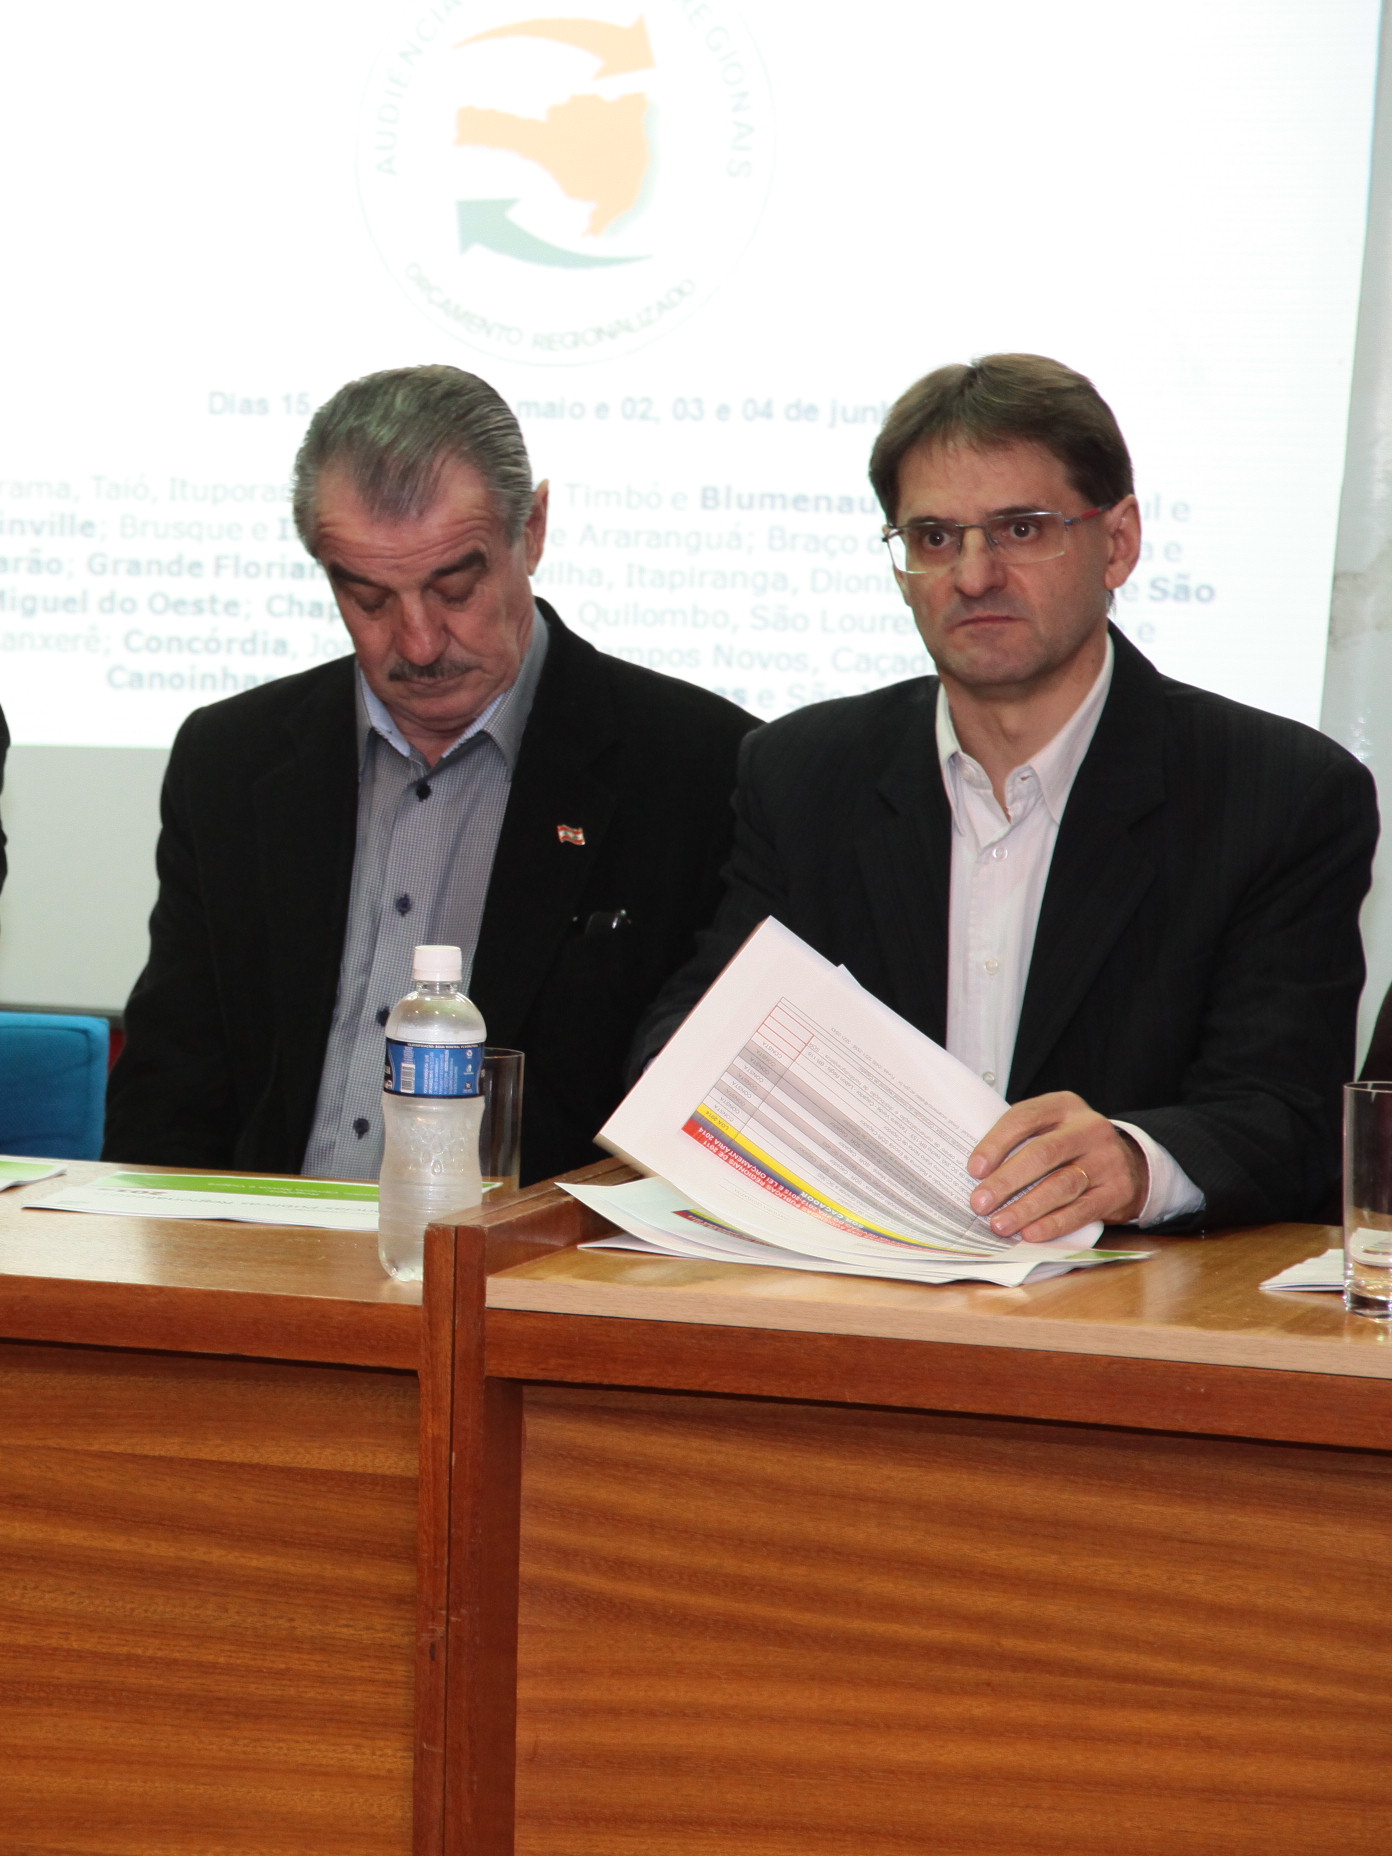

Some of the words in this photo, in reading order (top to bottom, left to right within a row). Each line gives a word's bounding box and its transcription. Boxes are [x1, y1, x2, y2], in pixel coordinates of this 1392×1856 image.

[209, 391, 269, 416] Dias
[516, 396, 586, 421] maio
[594, 402, 610, 421] e
[621, 396, 660, 424] 02,
[672, 398, 705, 422] 03
[716, 403, 732, 422] e
[743, 397, 775, 422] 04
[784, 398, 820, 424] de
[91, 473, 159, 505] Taió,
[565, 481, 663, 511] Timbó
[671, 491, 689, 511] e
[1171, 499, 1191, 522] e
[119, 513, 243, 544] Brusque
[251, 521, 269, 542] e
[550, 528, 568, 548] e
[578, 521, 755, 557] Araranguá;
[768, 526, 860, 558] Braço
[1163, 540, 1184, 563] e
[87, 552, 205, 579] Grande
[214, 554, 327, 581] Florian
[532, 561, 615, 594] vilha,
[626, 562, 799, 598] Itapiranga,
[1120, 580, 1140, 602] e
[1149, 573, 1216, 604] São
[99, 591, 137, 616] do
[148, 591, 252, 620] Oeste;
[266, 593, 341, 624] Chap
[578, 600, 739, 634] Quilombo,
[750, 601, 809, 633] São
[821, 607, 916, 636] Loure
[1136, 621, 1156, 644] e
[124, 626, 298, 660] Concórdia,
[713, 644, 821, 676] Novos,
[831, 645, 933, 681] Caçad
